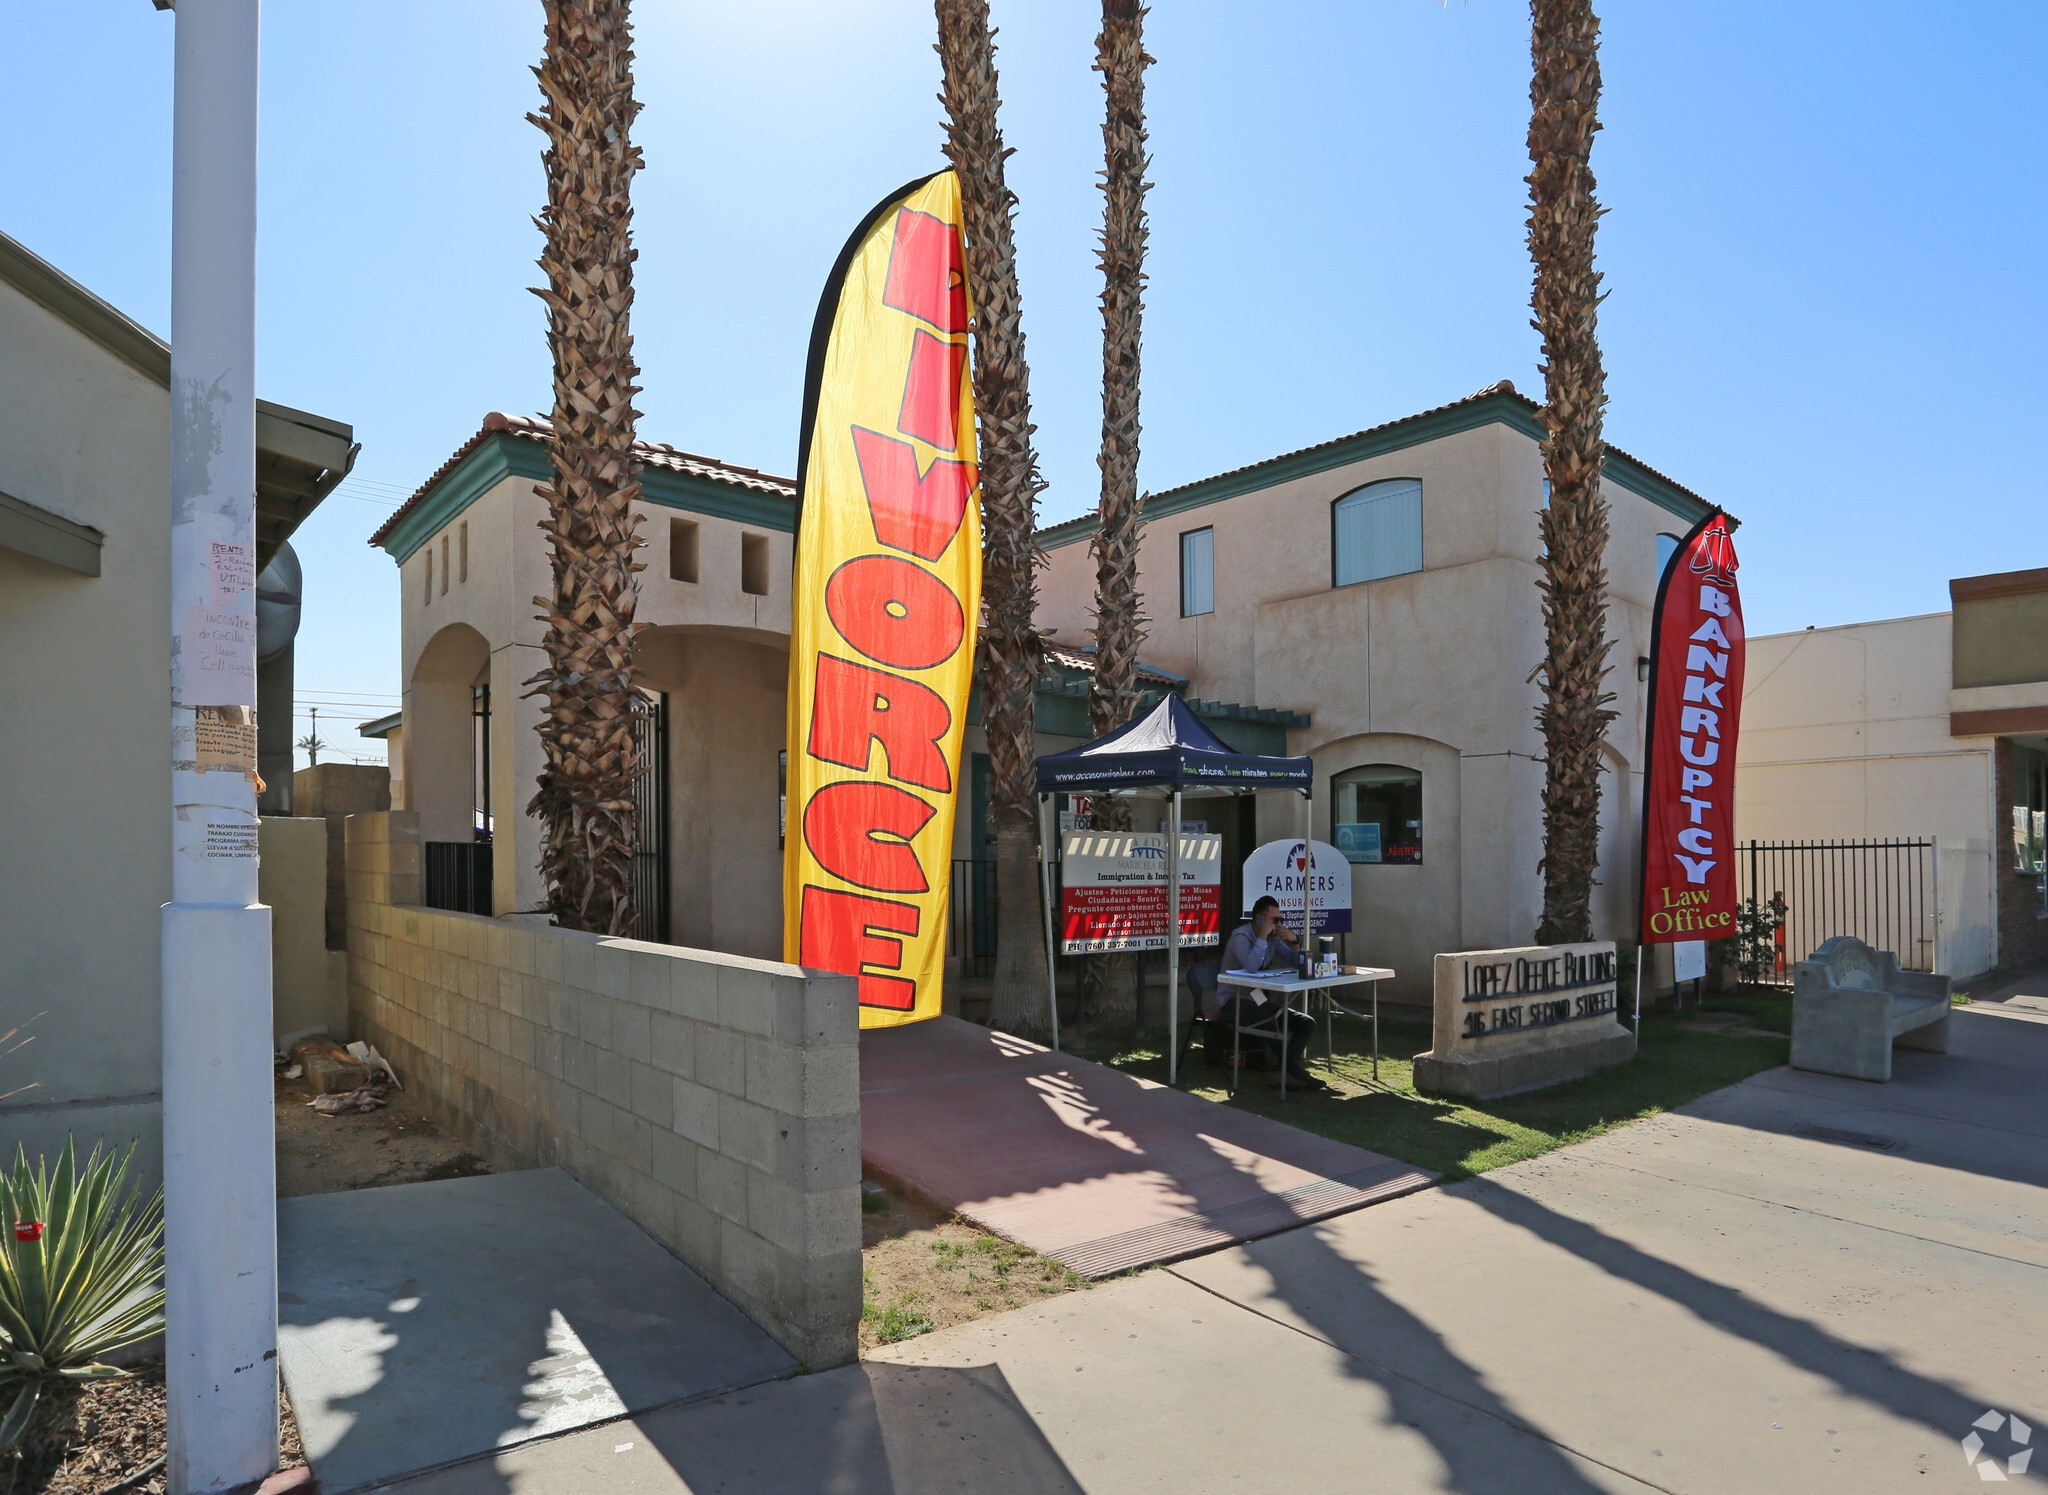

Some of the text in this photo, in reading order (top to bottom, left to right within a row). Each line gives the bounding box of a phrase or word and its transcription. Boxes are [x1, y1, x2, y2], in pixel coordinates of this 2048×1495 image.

[800, 204, 979, 1012] DIVORCE
[1673, 585, 1731, 884] BANKRUPTCY
[1056, 767, 1155, 781] www.accesswirelesscom
[1072, 796, 1092, 815] TA
[1097, 873, 1145, 882] Immigration
[1146, 873, 1154, 881] &
[1265, 876, 1335, 891] FARMERS
[1661, 886, 1711, 908] Law
[1068, 906, 1104, 914] Pregunte
[1151, 919, 1165, 927] tipo
[1650, 908, 1732, 934] Office
[1068, 943, 1082, 951] PH:
[1085, 941, 1106, 950] (760)
[1107, 940, 1141, 948] 357-7001
[1145, 938, 1167, 946] CELL:
[1464, 960, 1513, 998] LOPEZ
[1492, 1005, 1524, 1030] EAST
[1529, 999, 1570, 1024] SECOND
[1576, 990, 1615, 1016] STREET
